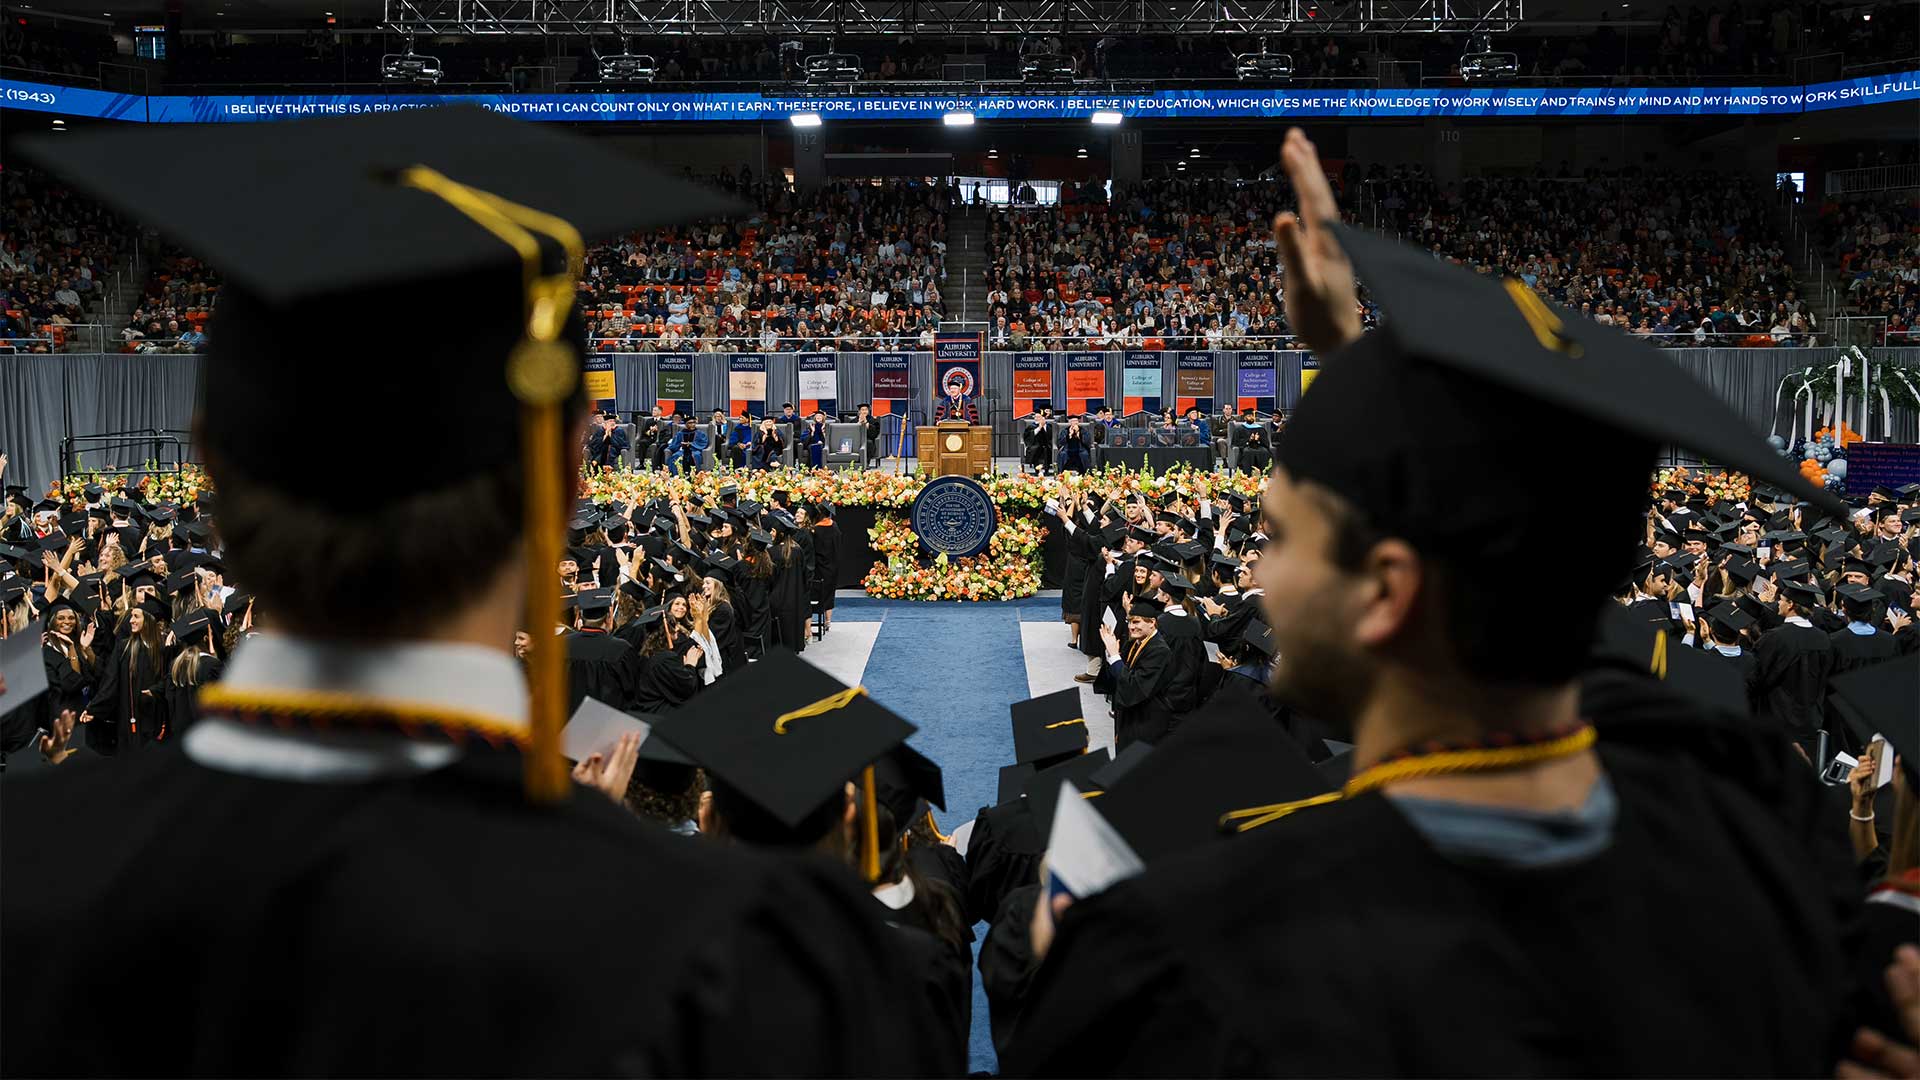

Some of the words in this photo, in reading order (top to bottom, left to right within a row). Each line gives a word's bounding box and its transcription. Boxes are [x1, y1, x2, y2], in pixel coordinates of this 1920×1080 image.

[6, 88, 55, 105] (1943)
[231, 104, 283, 114] BELIEVE
[284, 104, 317, 114] THAT
[318, 104, 347, 114] THIS
[350, 104, 362, 113] IS
[364, 103, 372, 113] A
[494, 103, 521, 113] AND
[521, 102, 554, 113] THAT
[562, 102, 588, 112] CAN
[590, 102, 635, 112] COUNT
[637, 102, 670, 112] ONLY
[671, 102, 691, 112] ON
[692, 102, 729, 112] WHAT
[737, 101, 774, 112] EARN.
[776, 101, 857, 112] THEREFORE,
[864, 101, 918, 111] BELIEVE
[919, 100, 933, 110] IN
[935, 100, 976, 110] WORK.
[978, 100, 1015, 110] HARD
[1016, 99, 1057, 110] WORK.
[1066, 99, 1121, 109] BELIEVE
[1123, 99, 1136, 109] IN
[1138, 98, 1215, 111] EDUCATION,
[1216, 98, 1259, 109] WHICH
[1261, 98, 1300, 108] GIVES
[1302, 98, 1321, 108] ME
[1322, 98, 1347, 108] THE
[1350, 97, 1431, 108] KNOWLEDGE
[1432, 97, 1450, 108] TO
[1451, 97, 1490, 107] WORK
[1492, 97, 1538, 107] WISELY
[1540, 97, 1568, 107] AND
[1569, 96, 1616, 107] TRAINS
[1618, 96, 1637, 106] MY
[1639, 96, 1672, 106] MIND
[1673, 96, 1701, 106] AND
[1703, 96, 1722, 105] MY
[1724, 95, 1769, 106] HANDS
[1770, 95, 1788, 105] TO
[1790, 90, 1837, 105] WORK
[1840, 80, 1920, 99] SKILLFULL
[798, 133, 817, 146] 112
[920, 493, 939, 531] AUBURN
[944, 485, 985, 534] UNIVERSITY
